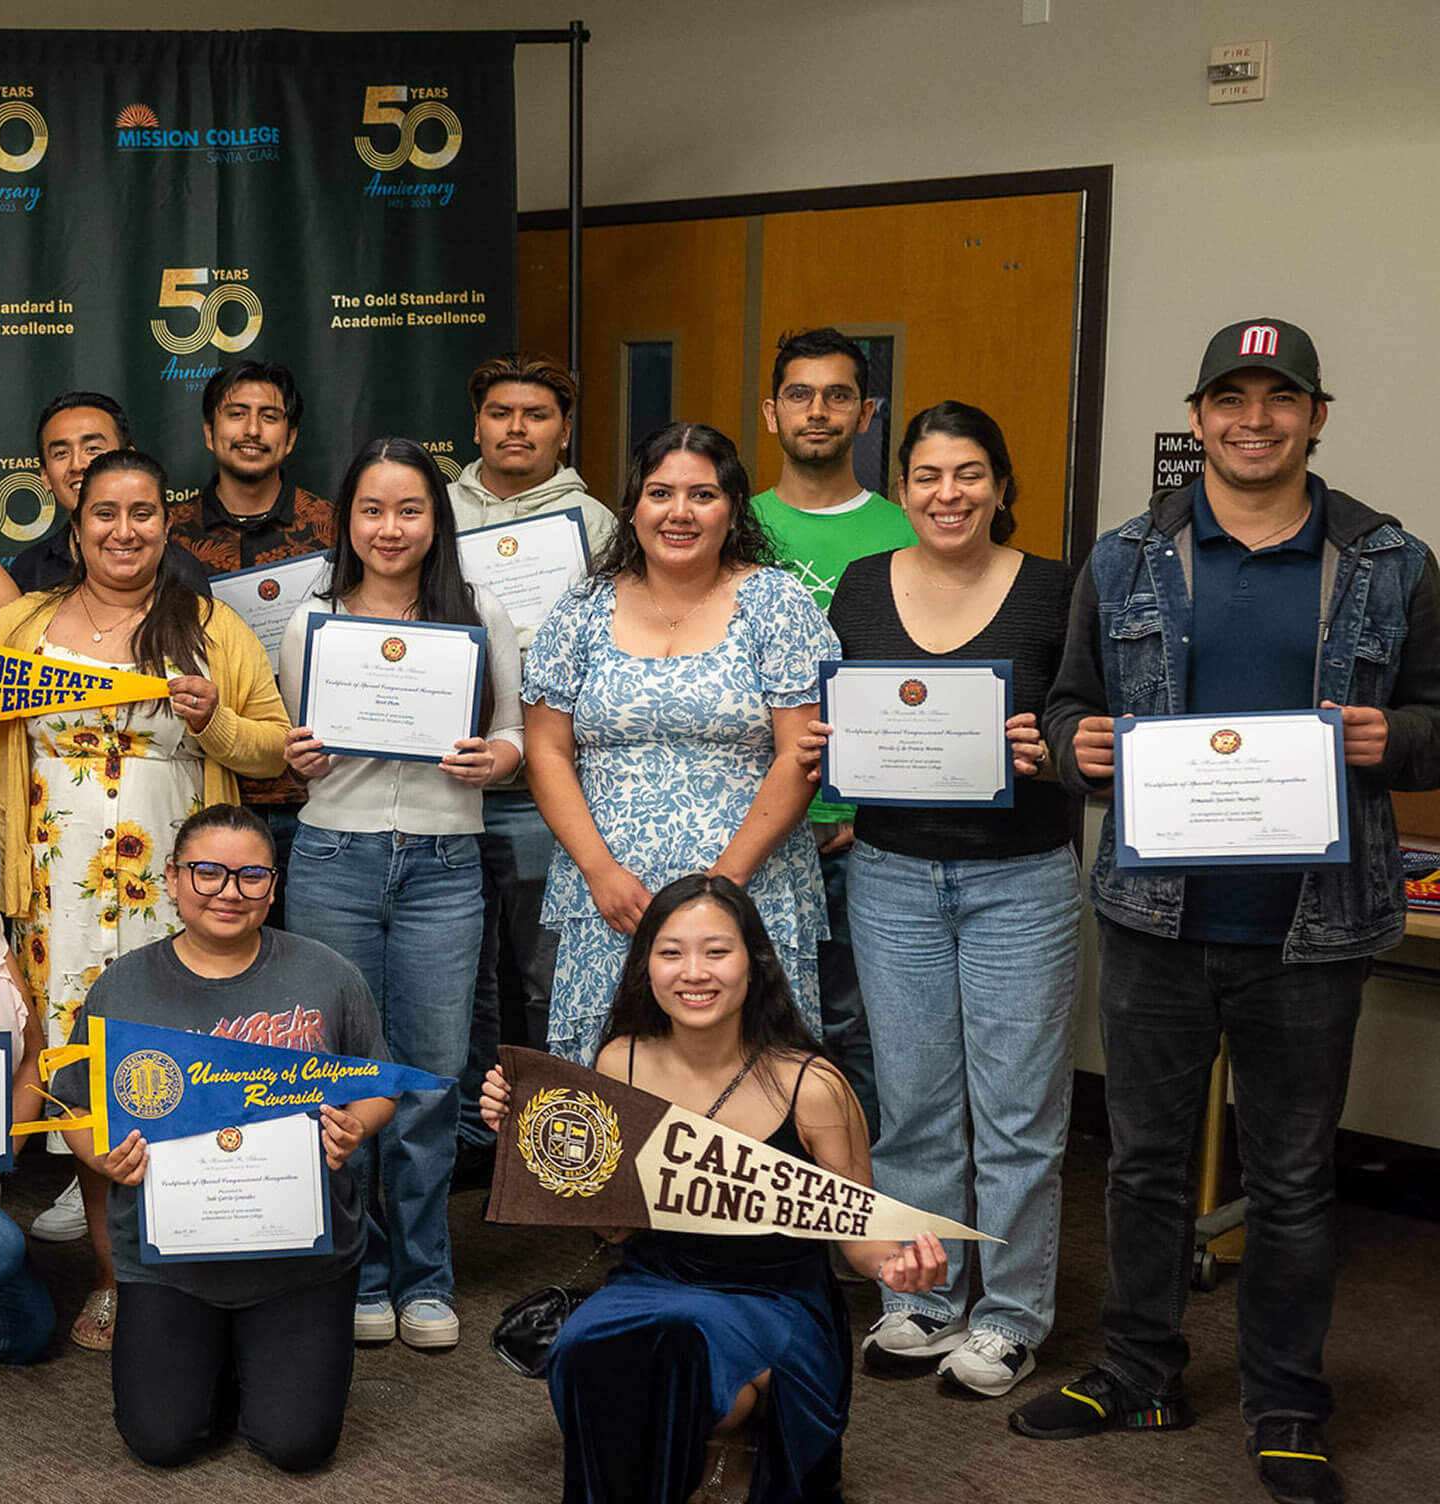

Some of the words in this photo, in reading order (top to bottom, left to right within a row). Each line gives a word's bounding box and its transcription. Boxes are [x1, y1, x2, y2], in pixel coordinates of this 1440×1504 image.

[1223, 48, 1251, 57] FIRE
[410, 87, 449, 99] YEARS
[1221, 85, 1249, 96] FIRE
[117, 130, 199, 147] MISSION
[206, 126, 280, 145] COLLEGE
[354, 85, 463, 171] 50
[363, 172, 455, 207] Anniversary
[212, 269, 250, 281] YEARS
[58, 299, 73, 313] in
[331, 295, 361, 309] The
[364, 293, 397, 307] Gold
[400, 291, 468, 306] Standard
[471, 290, 485, 303] in
[150, 267, 263, 354] 50
[331, 313, 404, 329] Academic
[407, 311, 487, 326] Excellence
[420, 440, 455, 453] ARS
[0, 457, 40, 470] YEARS
[1157, 474, 1183, 486] LAB
[37, 664, 114, 690] STATE
[187, 1060, 280, 1087] University
[281, 1061, 297, 1085] of
[301, 1057, 380, 1082] California
[244, 1085, 325, 1109] Riverside
[662, 1121, 876, 1215] CAL-STATE
[654, 1169, 764, 1224] LONG
[773, 1195, 869, 1237] BEACH
